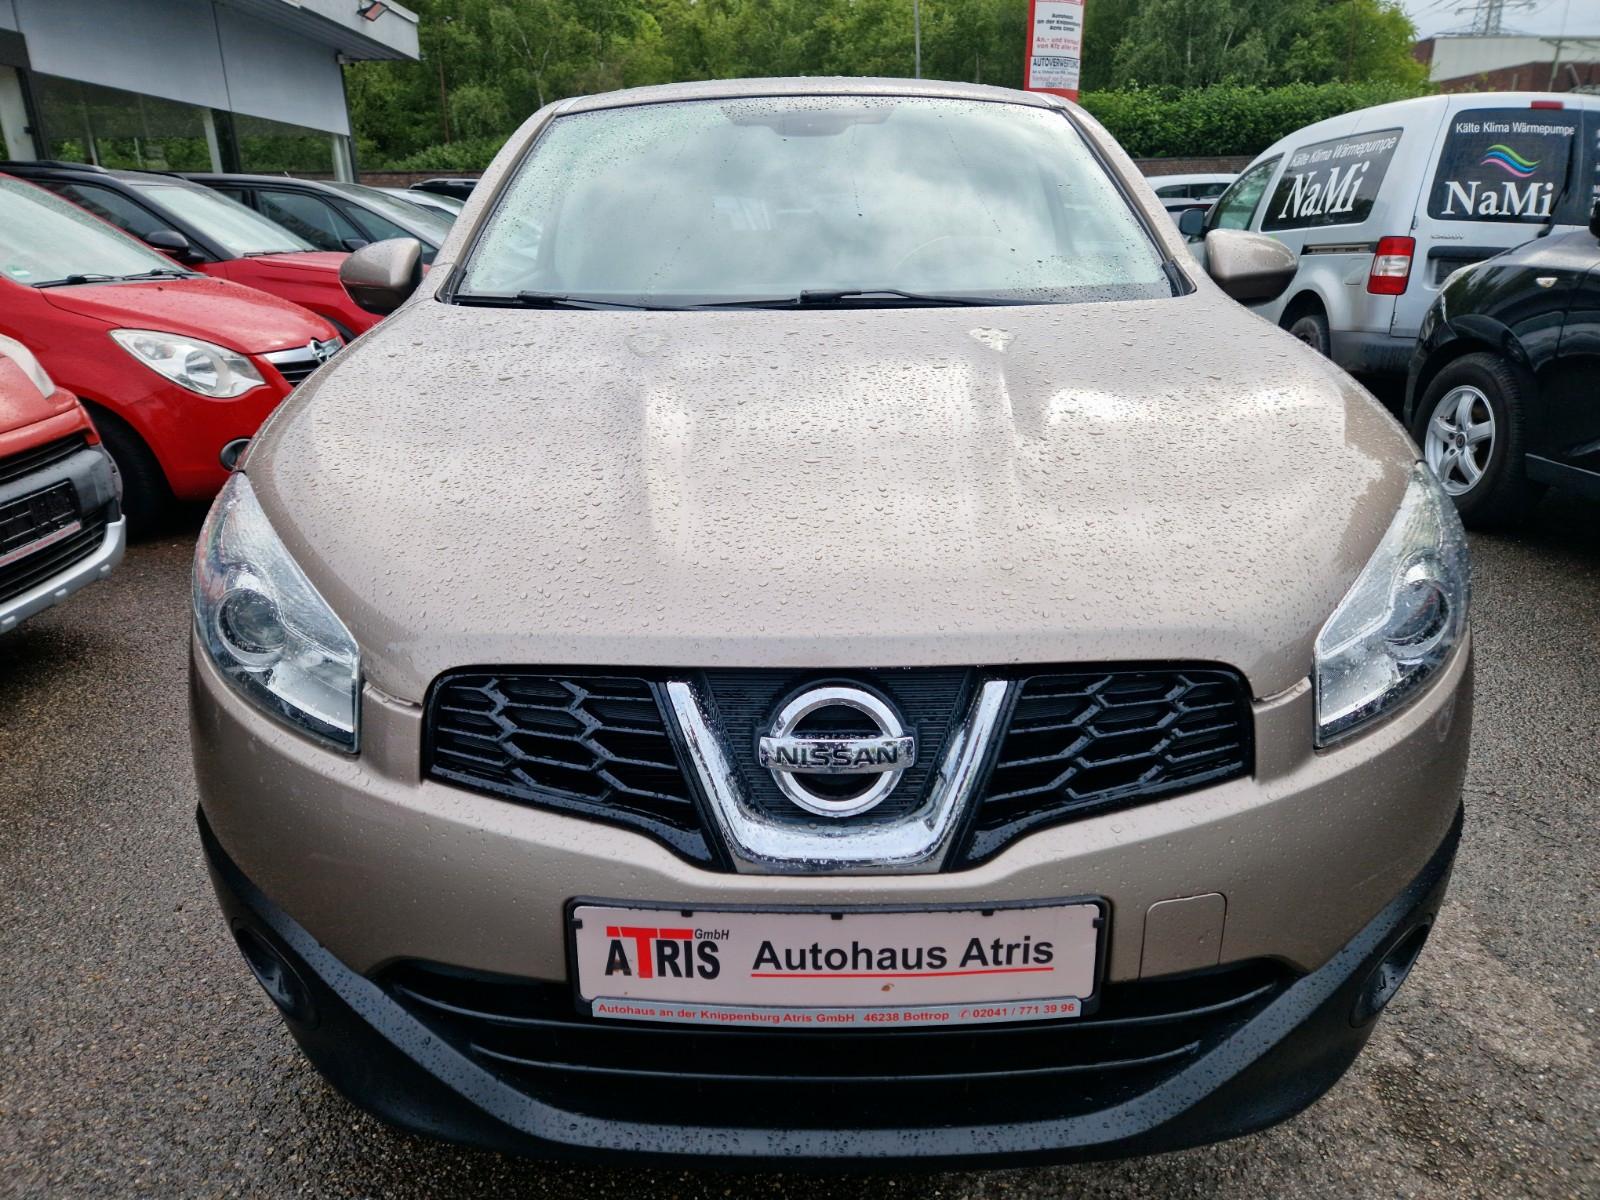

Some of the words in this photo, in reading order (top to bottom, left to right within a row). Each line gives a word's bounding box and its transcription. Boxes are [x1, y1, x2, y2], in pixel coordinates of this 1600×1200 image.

[1456, 122, 1481, 133] Kälte
[1483, 122, 1510, 133] Klima
[1512, 122, 1575, 136] Wärmepumpe
[1333, 136, 1397, 159] Wärmepumpe
[1278, 160, 1370, 219] NaMi
[1441, 181, 1554, 217] NaMi
[775, 745, 899, 767] NISSAN
[605, 926, 720, 980] ATRIS
[694, 928, 730, 941] GmbH
[752, 940, 947, 971] Autohaus
[959, 935, 1054, 968] Atris
[598, 1003, 656, 1016] Autohaus
[659, 1009, 674, 1018] an
[677, 1009, 698, 1019] der
[700, 1010, 781, 1024] Knippenburg
[783, 1012, 813, 1023] Atris
[816, 1013, 855, 1023] GmbH
[863, 1012, 900, 1022] 46238
[903, 1011, 950, 1022] Bottrop
[972, 1007, 1008, 1018] 02041
[1019, 1005, 1040, 1015] 771
[1043, 1003, 1057, 1014] 39
[1060, 1002, 1075, 1013] 96
